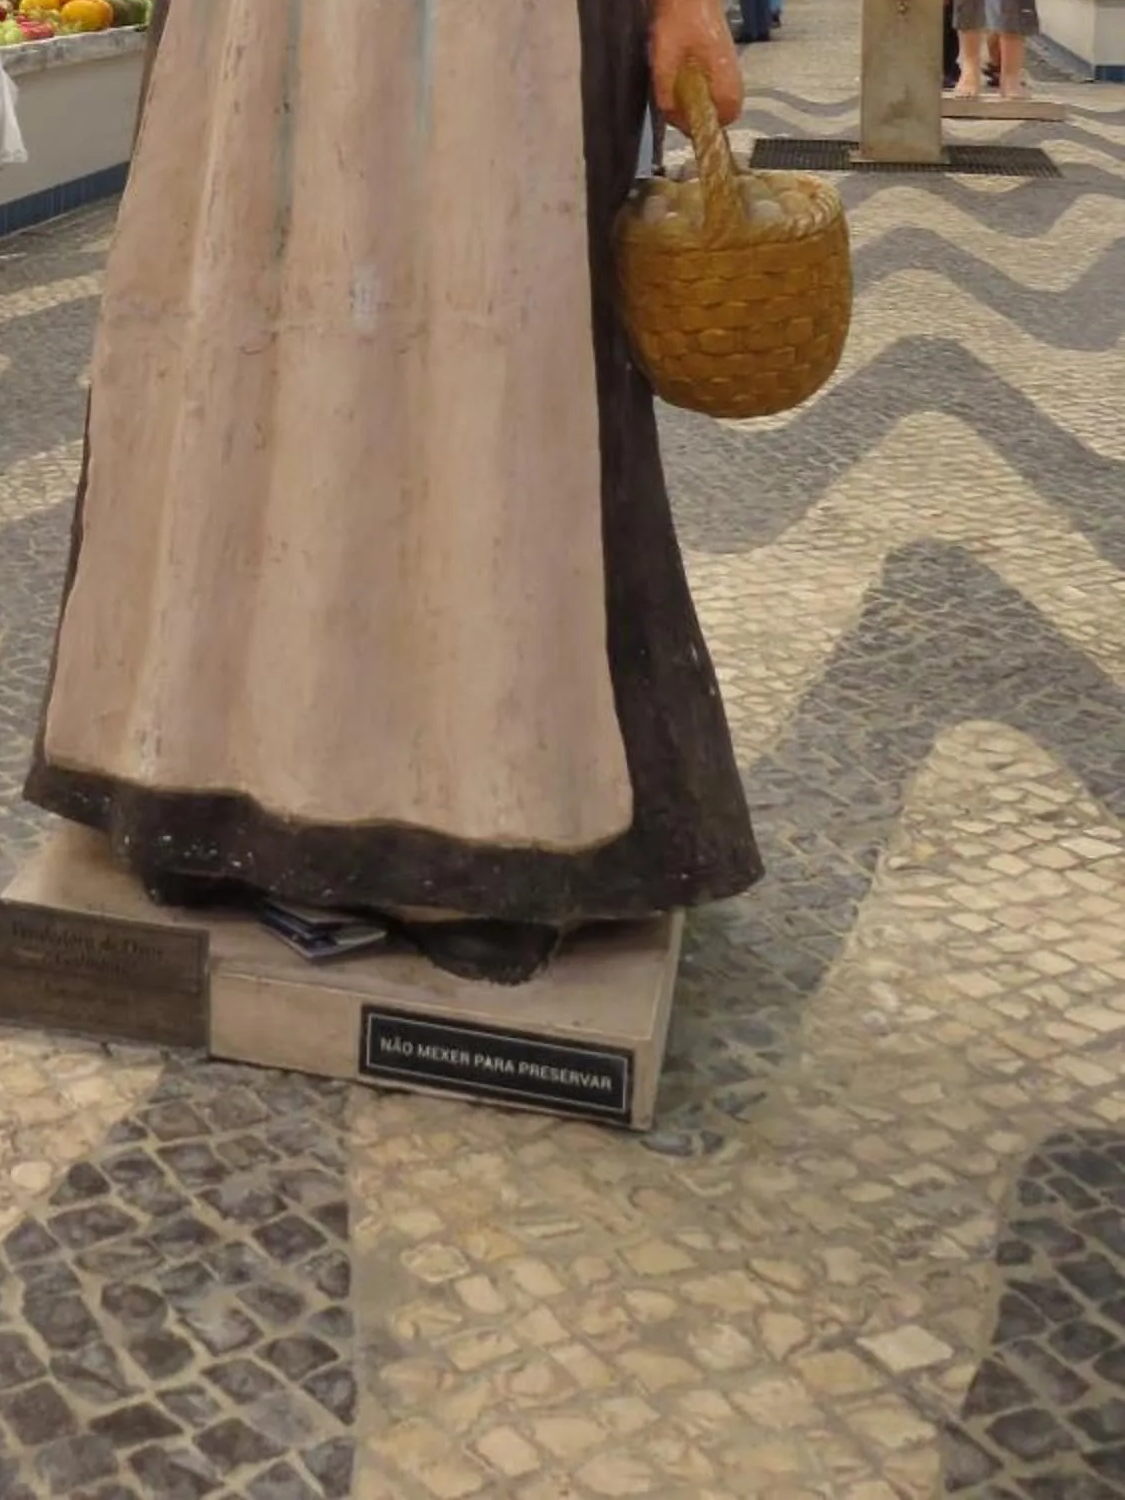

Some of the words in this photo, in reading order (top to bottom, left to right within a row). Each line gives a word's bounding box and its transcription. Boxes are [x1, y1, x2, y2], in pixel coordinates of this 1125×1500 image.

[379, 1036, 413, 1057] NÃO
[416, 1043, 470, 1066] MEXER
[474, 1054, 515, 1074] PARA
[518, 1062, 613, 1092] PRESERVAR
